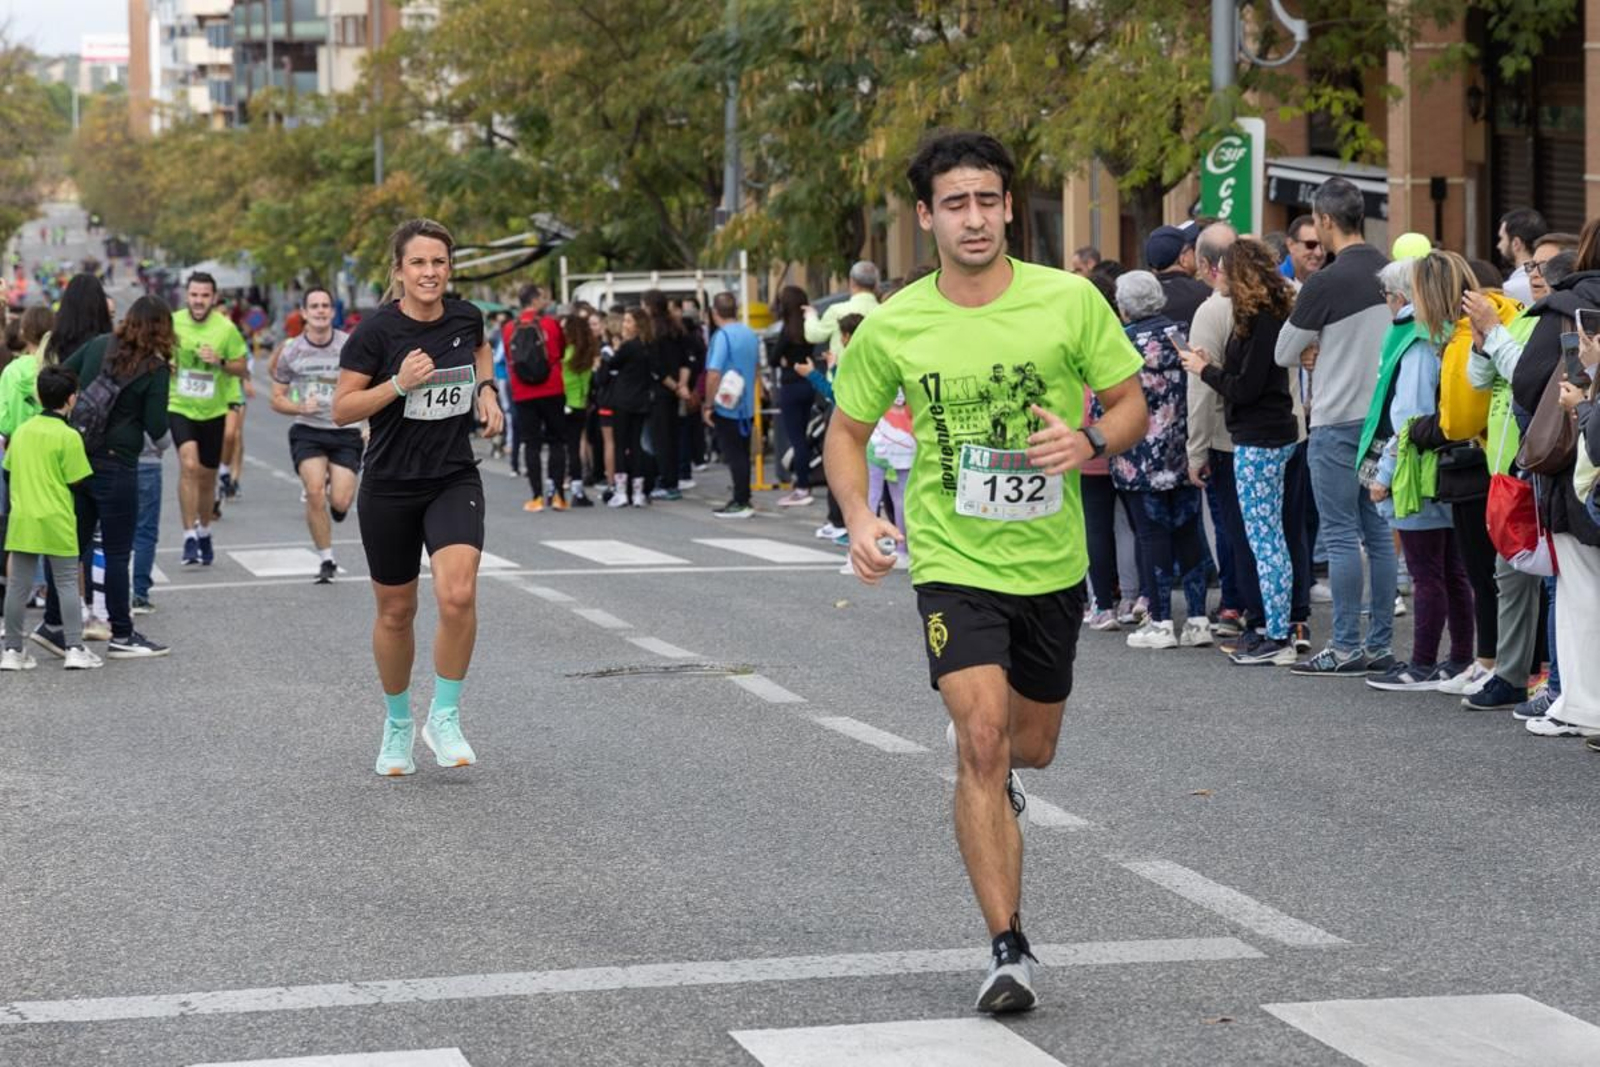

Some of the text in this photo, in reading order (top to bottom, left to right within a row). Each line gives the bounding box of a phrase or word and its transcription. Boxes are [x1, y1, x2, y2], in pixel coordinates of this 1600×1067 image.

[1217, 177, 1236, 221] CS
[423, 386, 461, 408] 146
[919, 372, 941, 403] 17
[929, 403, 958, 491] noviembre
[983, 475, 1047, 503] 132
